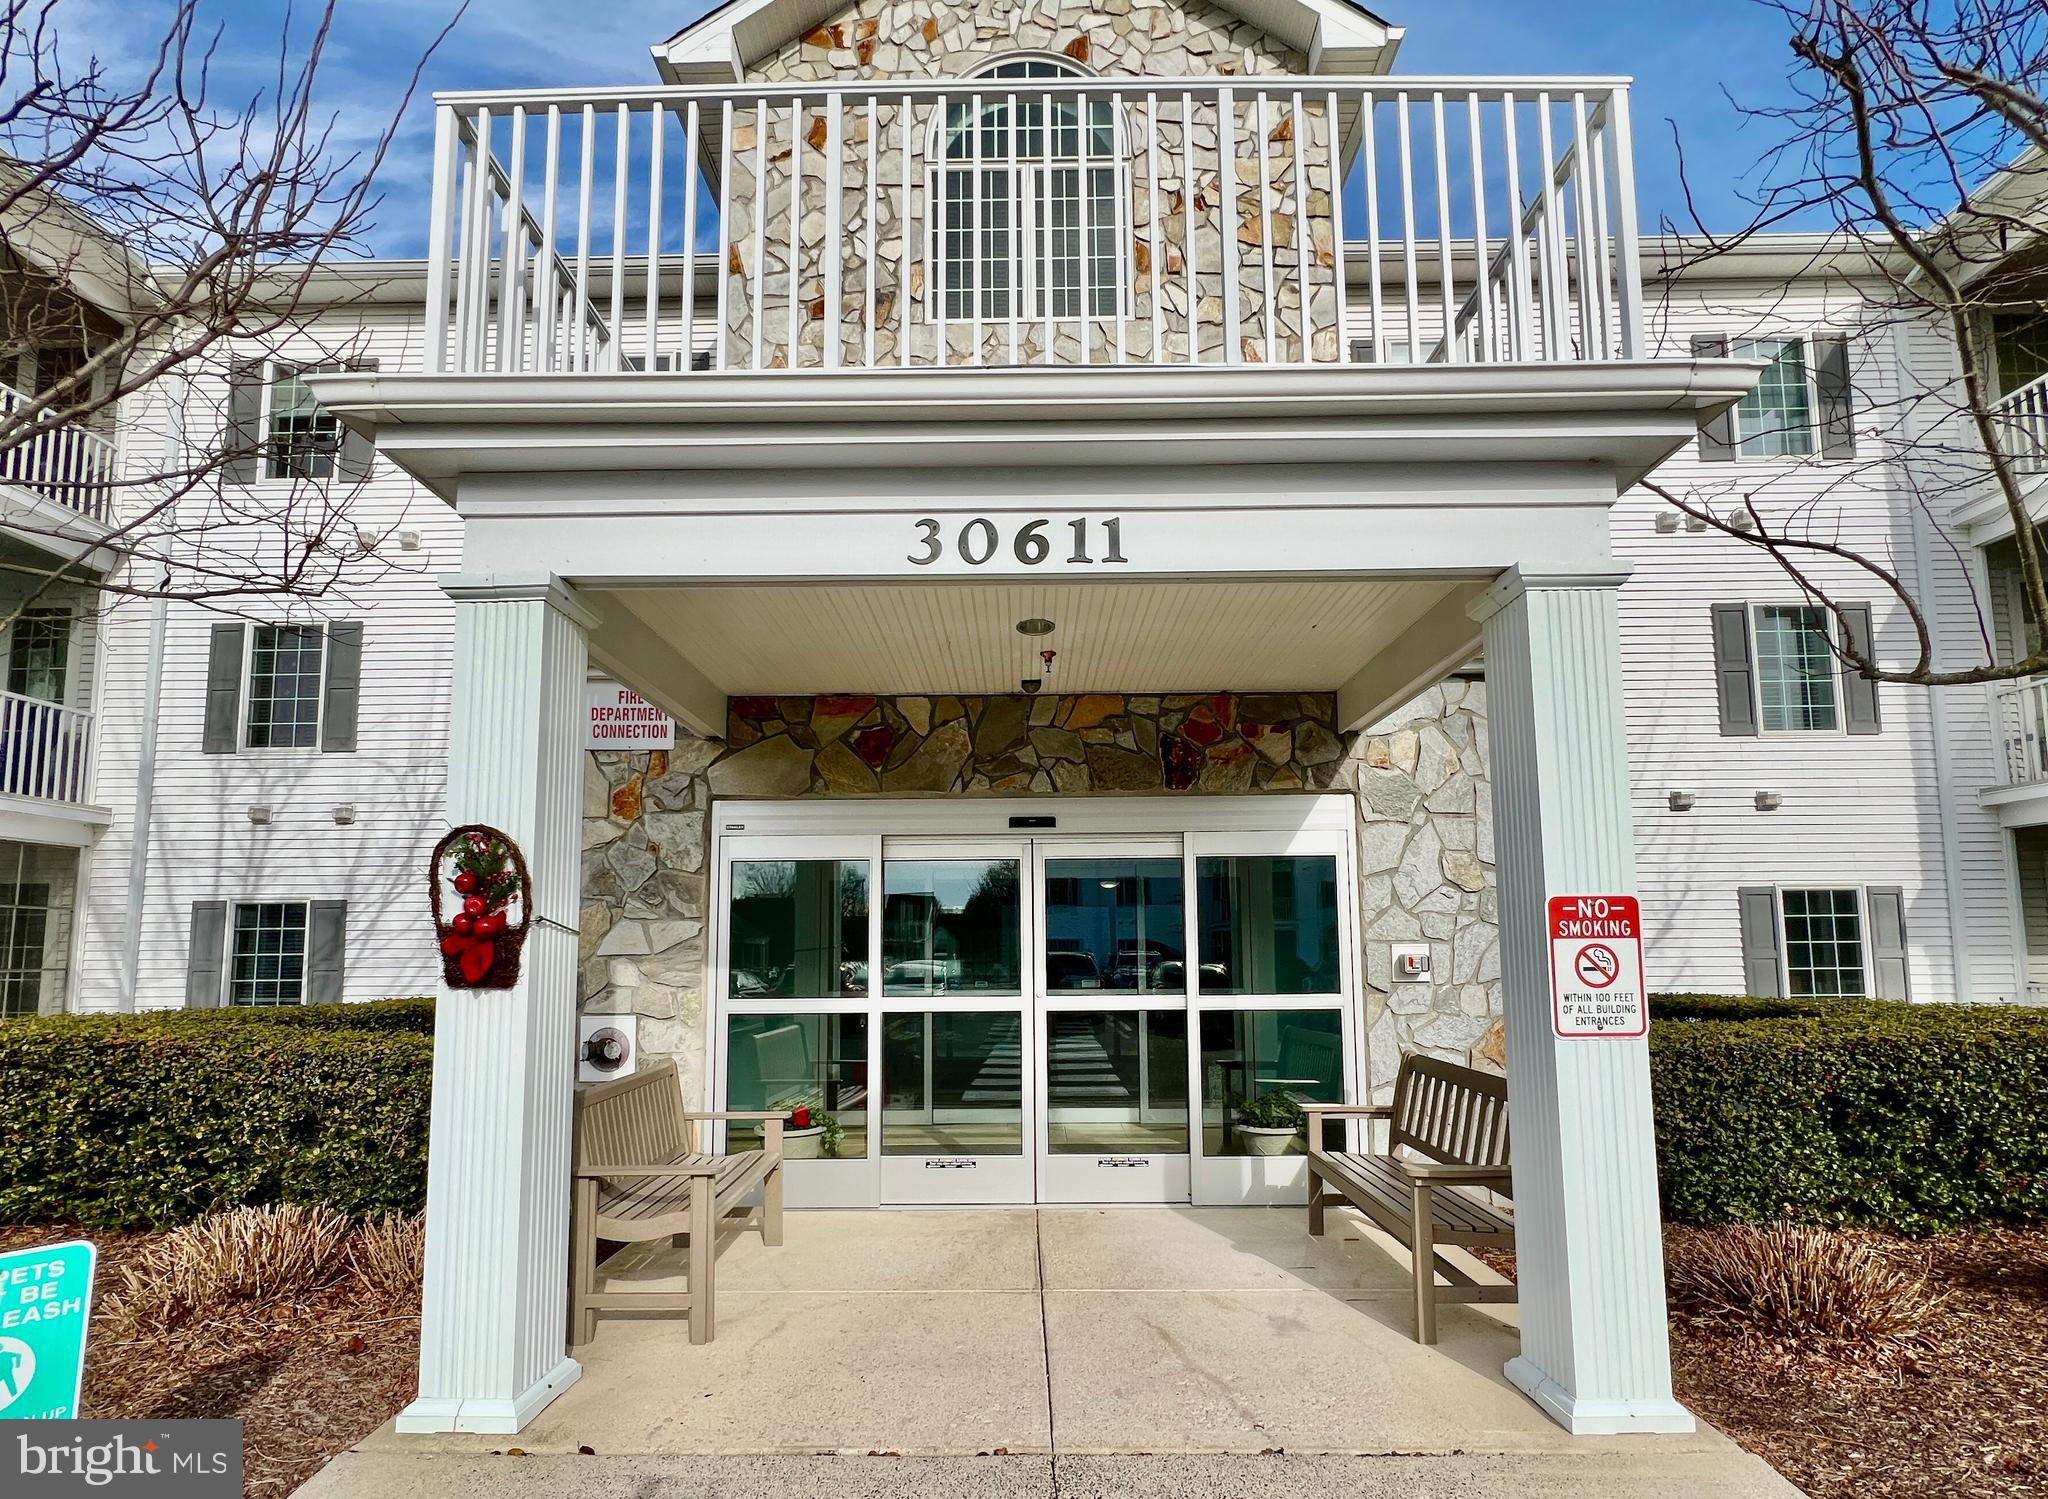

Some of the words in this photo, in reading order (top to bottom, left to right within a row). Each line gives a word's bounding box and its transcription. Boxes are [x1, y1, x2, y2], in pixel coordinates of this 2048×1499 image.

[906, 517, 1129, 565] 30611
[592, 724, 668, 738] CONNECTION
[1558, 919, 1632, 937] SMOKING
[1563, 993, 1592, 1003] WITHIN
[1595, 993, 1611, 1003] 100
[1614, 993, 1635, 1003] FEET
[1562, 1004, 1575, 1015] OF
[1577, 1004, 1593, 1015] ALL
[1596, 1004, 1637, 1014] BUILDING
[1575, 1016, 1626, 1026] ENTRANCES
[20, 1281, 59, 1304] BE
[2, 1297, 82, 1329] EASH
